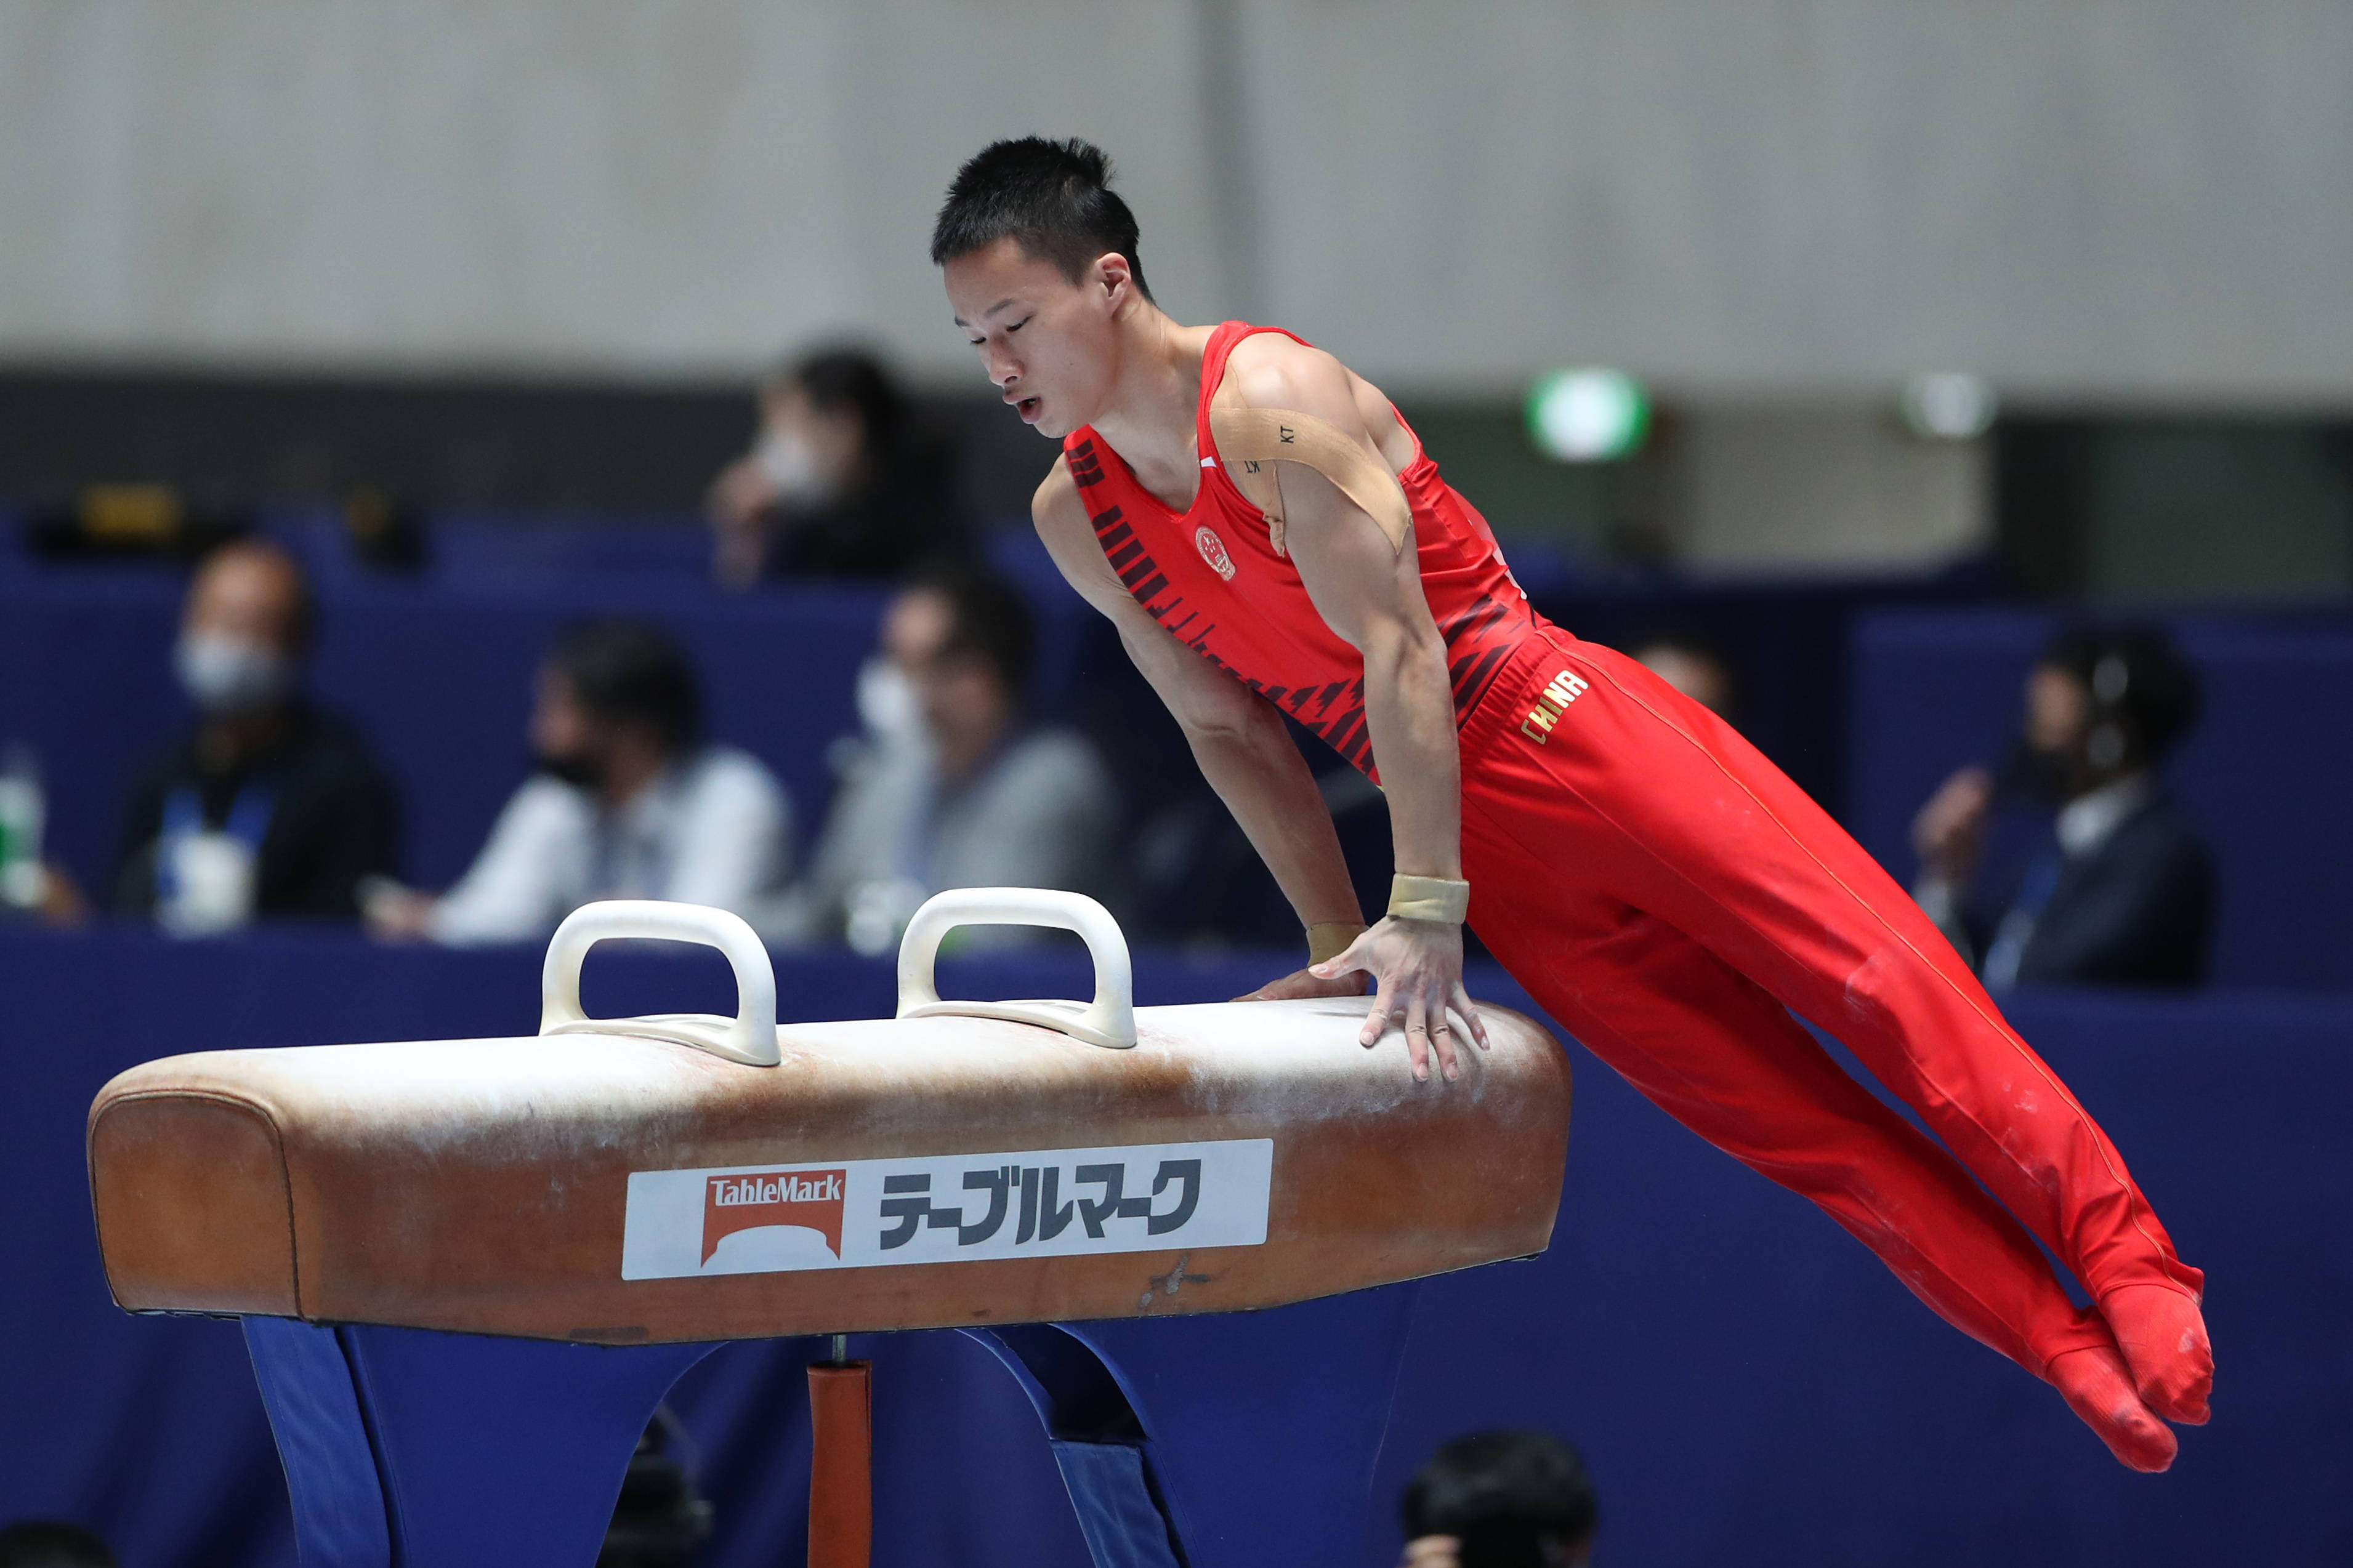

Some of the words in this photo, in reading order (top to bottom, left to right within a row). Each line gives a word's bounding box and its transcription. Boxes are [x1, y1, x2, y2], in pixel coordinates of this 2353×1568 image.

[1280, 425, 1294, 443] KT
[1244, 460, 1261, 473] KT
[1521, 670, 1589, 745] CHINA
[710, 1174, 843, 1207] TableMark
[880, 1159, 1201, 1250] テーブルマーク
